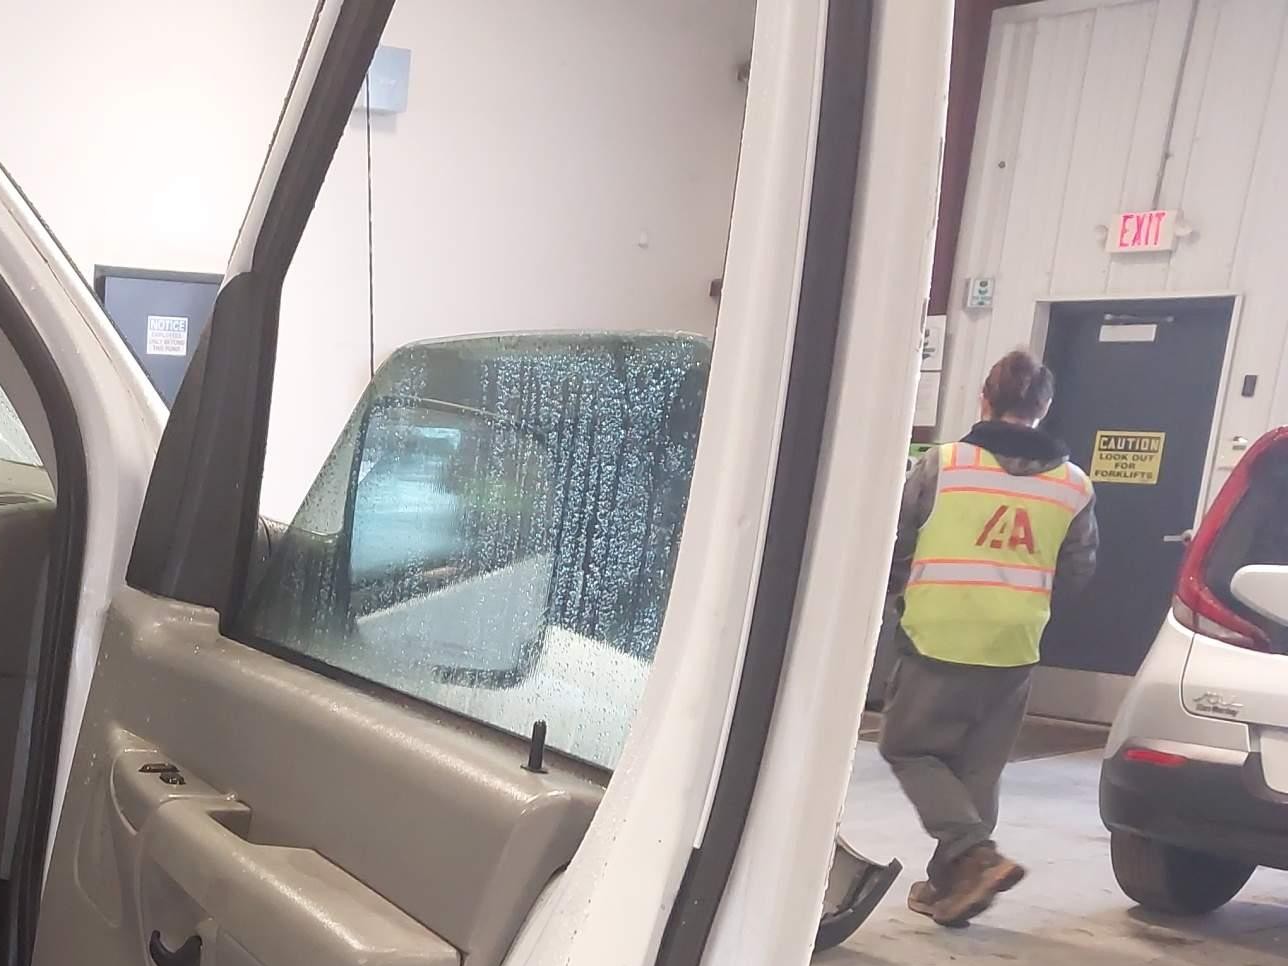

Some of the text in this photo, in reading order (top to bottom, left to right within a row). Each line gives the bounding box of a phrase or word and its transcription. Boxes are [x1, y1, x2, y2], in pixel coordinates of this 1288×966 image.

[1119, 212, 1166, 247] EXIT
[150, 319, 185, 331] NOTICE
[1099, 436, 1160, 452] CAUTION
[1099, 453, 1155, 462] LOOK OUT
[1114, 462, 1136, 470] FOR
[1094, 470, 1153, 479] FORKLIFTS
